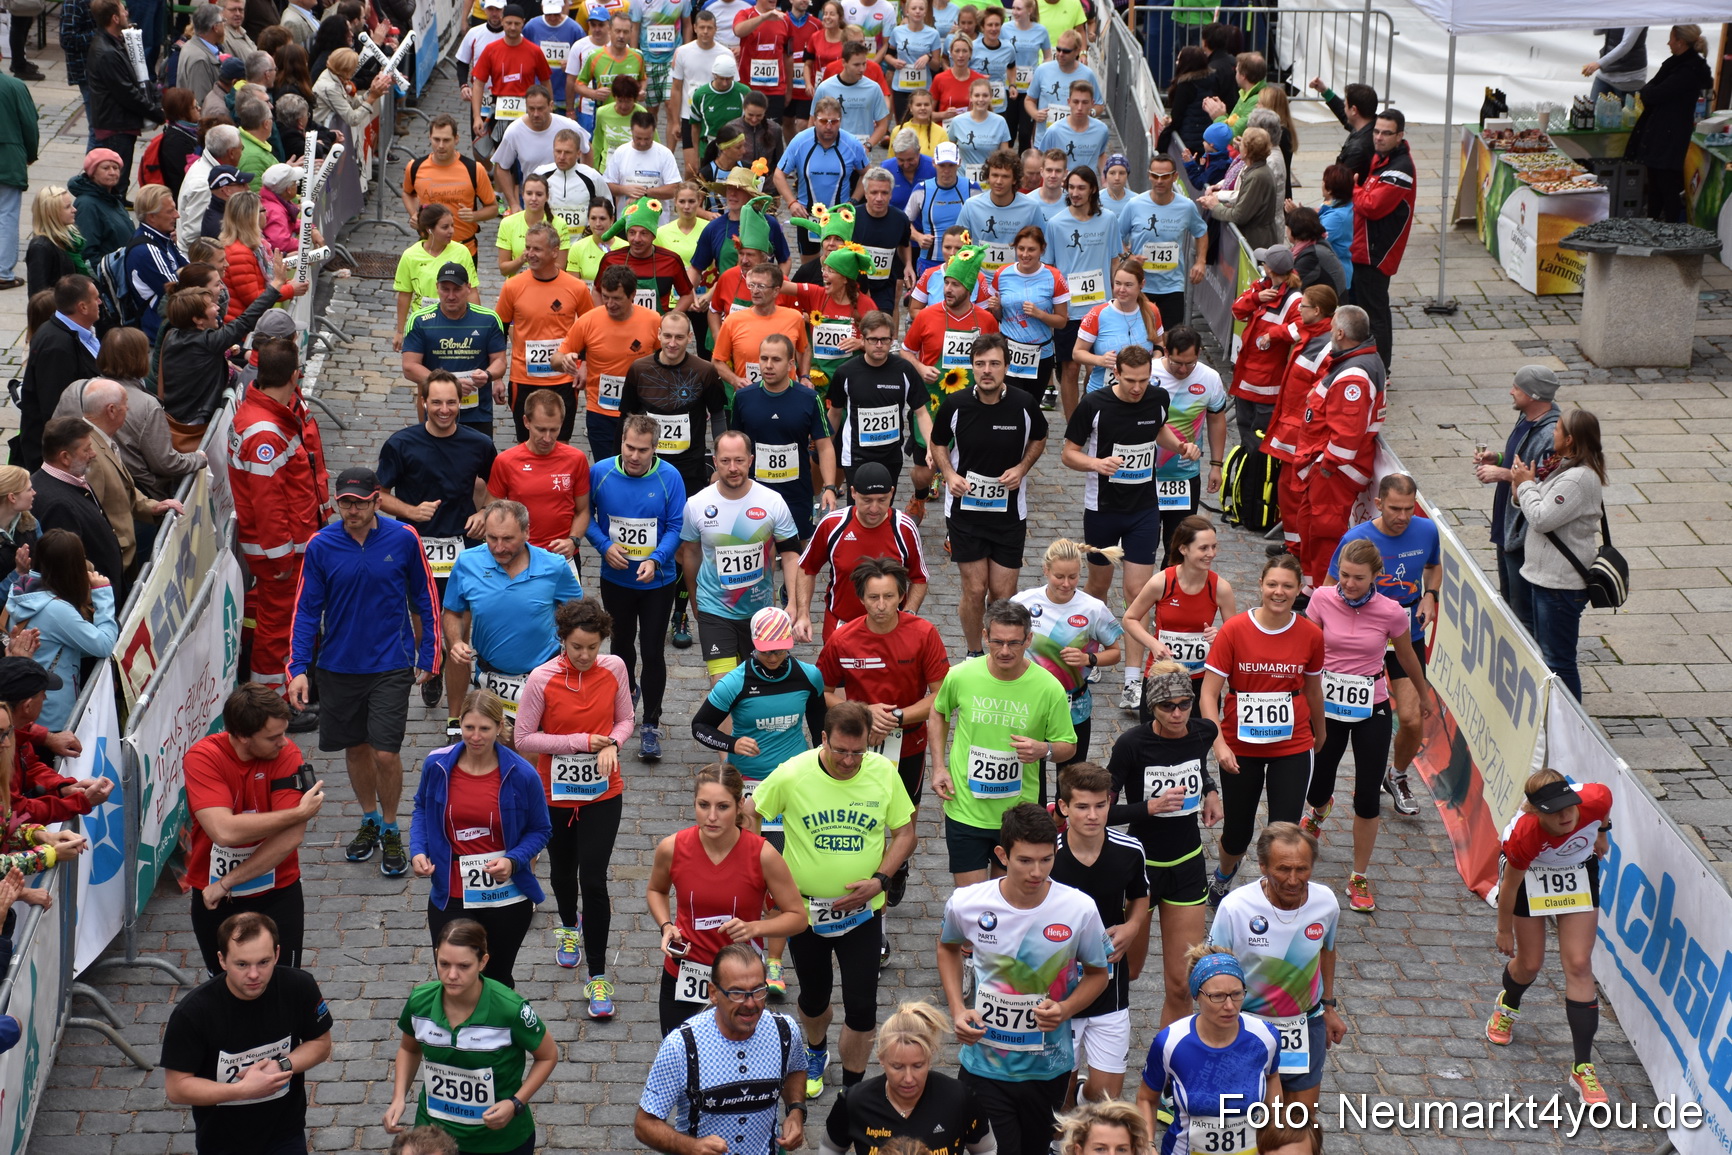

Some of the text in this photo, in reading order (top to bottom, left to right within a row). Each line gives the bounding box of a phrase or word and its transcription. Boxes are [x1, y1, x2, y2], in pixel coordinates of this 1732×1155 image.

[650, 31, 672, 42] 2442
[546, 48, 564, 59] 314
[754, 66, 776, 76] 2407
[905, 70, 921, 80] 191
[502, 98, 521, 110] 237
[423, 186, 466, 198] Alexander
[990, 250, 1004, 262] 14
[1151, 250, 1172, 262] 143
[1081, 279, 1096, 292] 49
[440, 338, 473, 350] Blond!
[862, 414, 896, 432] 2281
[768, 454, 786, 468] 88
[1118, 452, 1151, 468] 2270
[968, 482, 1006, 498] 2135
[610, 518, 625, 526] PARTL
[618, 526, 647, 544] 326
[426, 544, 456, 560] 219
[722, 552, 760, 573] 2187
[728, 572, 758, 584] Benjamin
[1238, 662, 1296, 674] NEUMARKT
[1326, 683, 1369, 705] 2169
[972, 696, 1029, 714] NOVINA
[1336, 706, 1352, 716] Lisa
[756, 713, 800, 727] HUBER
[1244, 704, 1289, 724] 2160
[971, 712, 1027, 730] HOTELS
[1250, 728, 1282, 737] Christina
[971, 750, 988, 758] PARTL
[974, 760, 1019, 780] 2580
[1168, 767, 1192, 777] Neumarkt
[566, 785, 596, 794] Stefanie
[980, 784, 1008, 792] Thomas
[802, 809, 878, 832] FINISHER
[464, 830, 480, 838] DEHN
[213, 846, 230, 858] PARTL
[468, 868, 506, 888] 20
[1538, 872, 1577, 894] 193
[482, 890, 509, 900] Sabine
[1544, 898, 1576, 908] Claudia
[978, 932, 997, 940] PARTL
[681, 966, 702, 976] PARTL
[978, 990, 1034, 1006] PARTL Neumarkt
[982, 1002, 1037, 1030] 2579
[990, 1030, 1025, 1044] Samuel
[220, 1046, 280, 1064] PARTL Neumarkt
[426, 1064, 480, 1080] PARTL Neumarkt
[432, 1075, 488, 1104] 2596
[720, 1093, 770, 1106] jagafit.de
[444, 1104, 475, 1117] Andrea
[1192, 1120, 1216, 1130] PARTL
[866, 1126, 892, 1138] Angelas
[1205, 1127, 1246, 1152] 381
